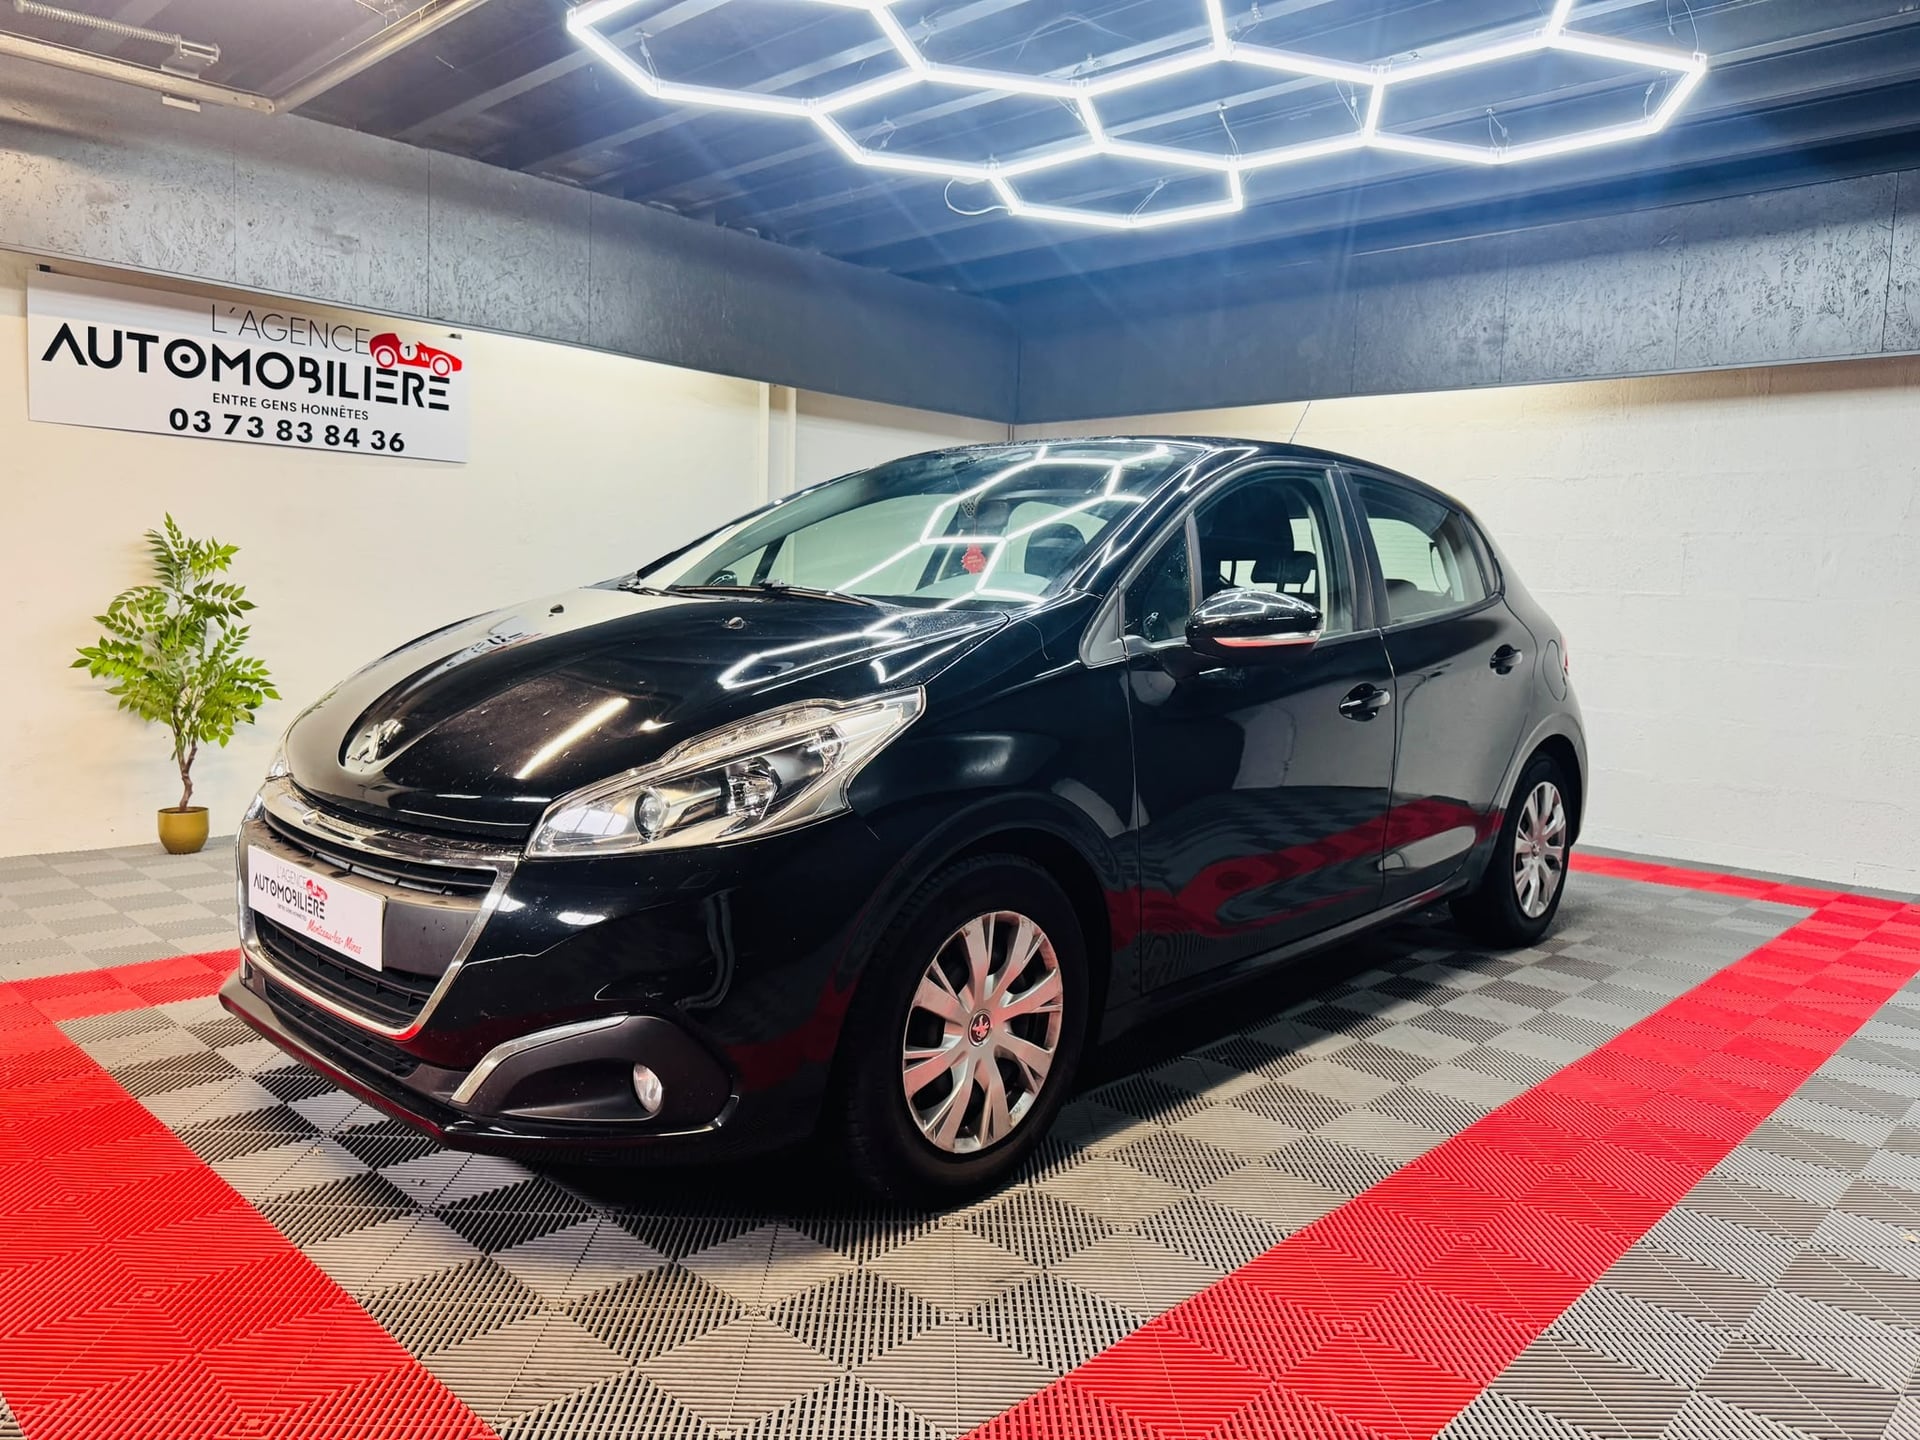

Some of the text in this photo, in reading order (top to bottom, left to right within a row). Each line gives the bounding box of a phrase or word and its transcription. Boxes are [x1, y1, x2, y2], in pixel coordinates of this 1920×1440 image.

[211, 304, 370, 355] L'AGENCE
[213, 393, 369, 421] ENTRE GENS HONNÊTES
[169, 408, 406, 452] 03 73 83 84 36
